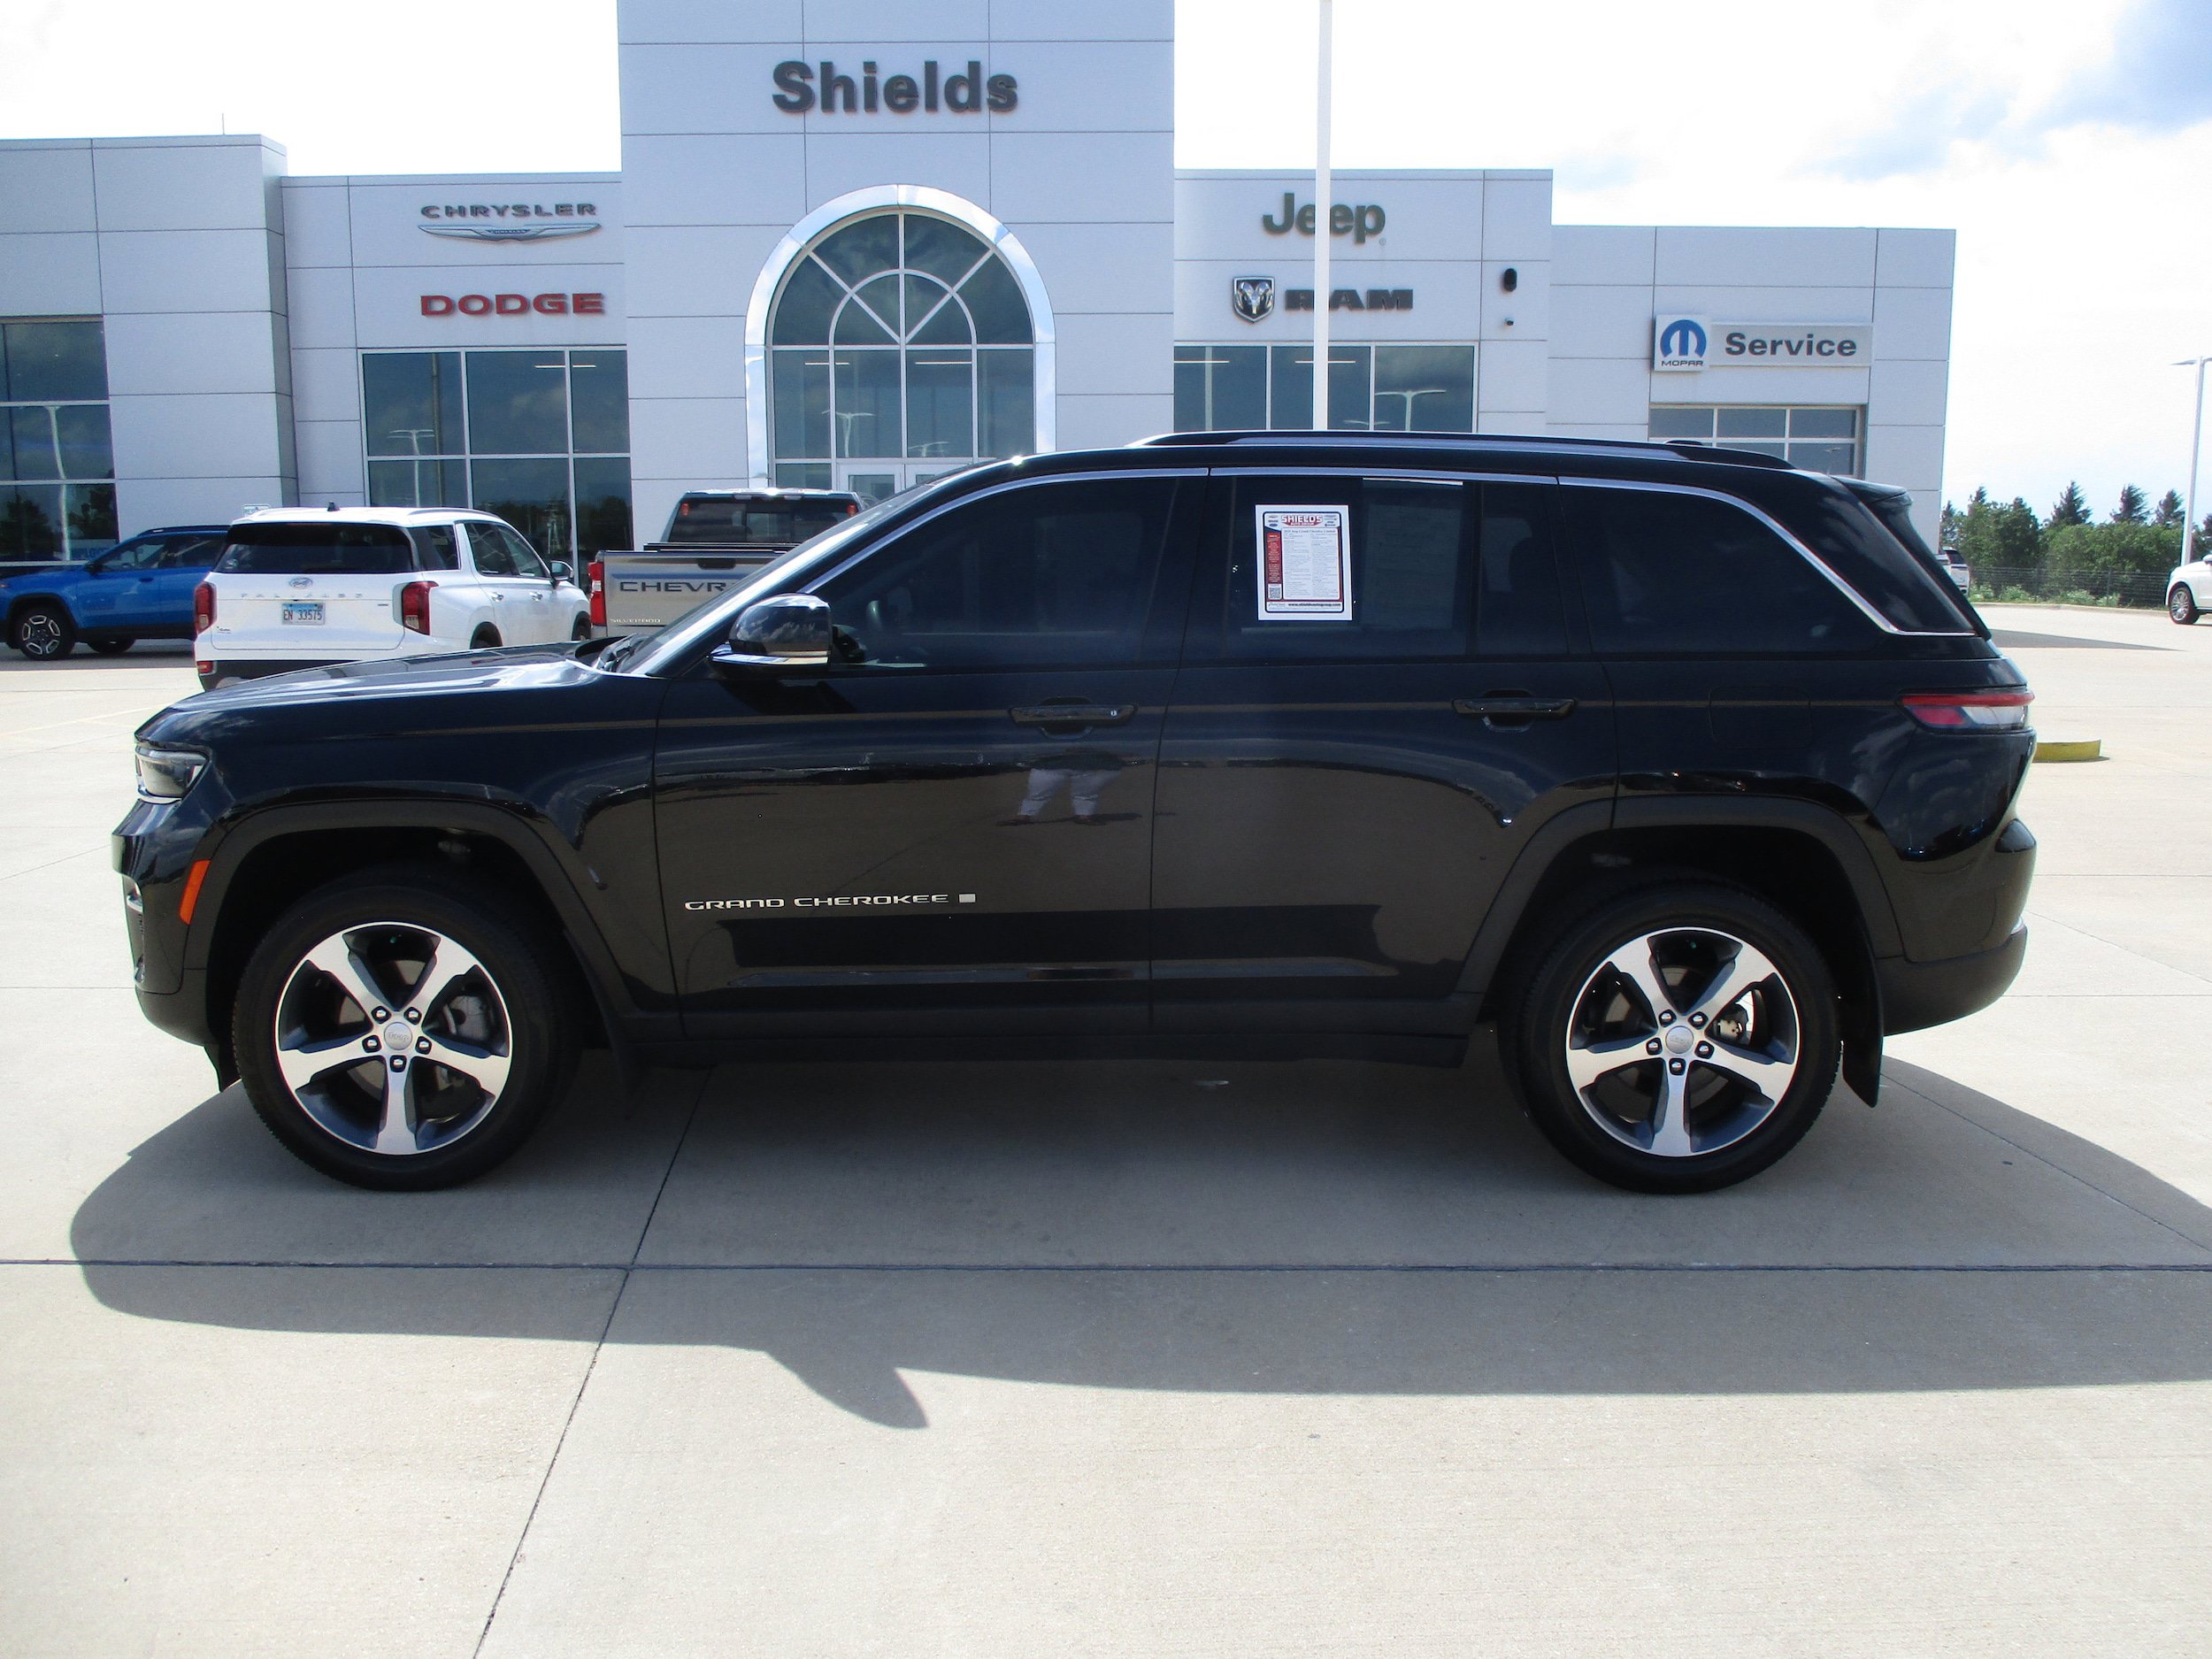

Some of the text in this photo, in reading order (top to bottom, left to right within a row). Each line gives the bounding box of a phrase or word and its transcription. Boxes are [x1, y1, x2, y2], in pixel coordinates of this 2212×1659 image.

[772, 60, 1018, 113] Shields
[420, 204, 597, 219] CHRYSLER
[1263, 192, 1386, 244] Jeep
[420, 293, 603, 316] DODGE
[1286, 289, 1413, 311] RAM
[1725, 333, 1856, 357] Service
[620, 581, 735, 592] CHEVR
[283, 609, 323, 621] EN 33575
[685, 894, 949, 910] GRAND CHEROKEE
